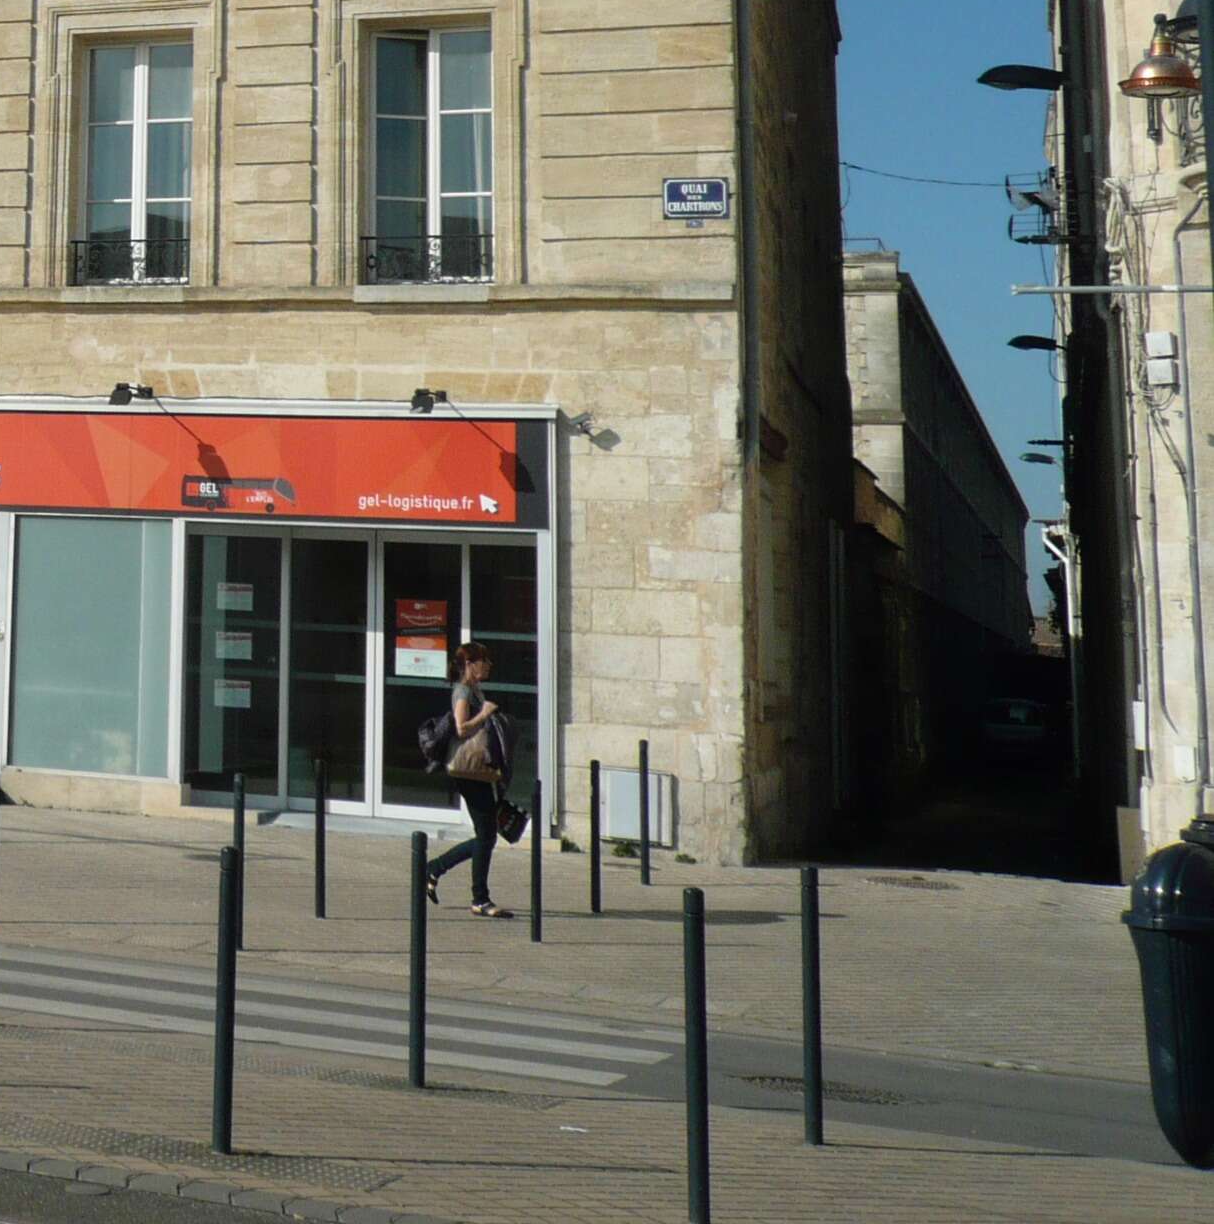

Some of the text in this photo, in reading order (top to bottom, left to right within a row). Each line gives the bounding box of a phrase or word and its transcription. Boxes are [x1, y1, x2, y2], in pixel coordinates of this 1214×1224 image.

[681, 183, 707, 195] QUAI
[668, 201, 722, 212] CHARTRONS
[199, 482, 219, 494] GEL
[358, 493, 474, 512] gel-logistique.fr
